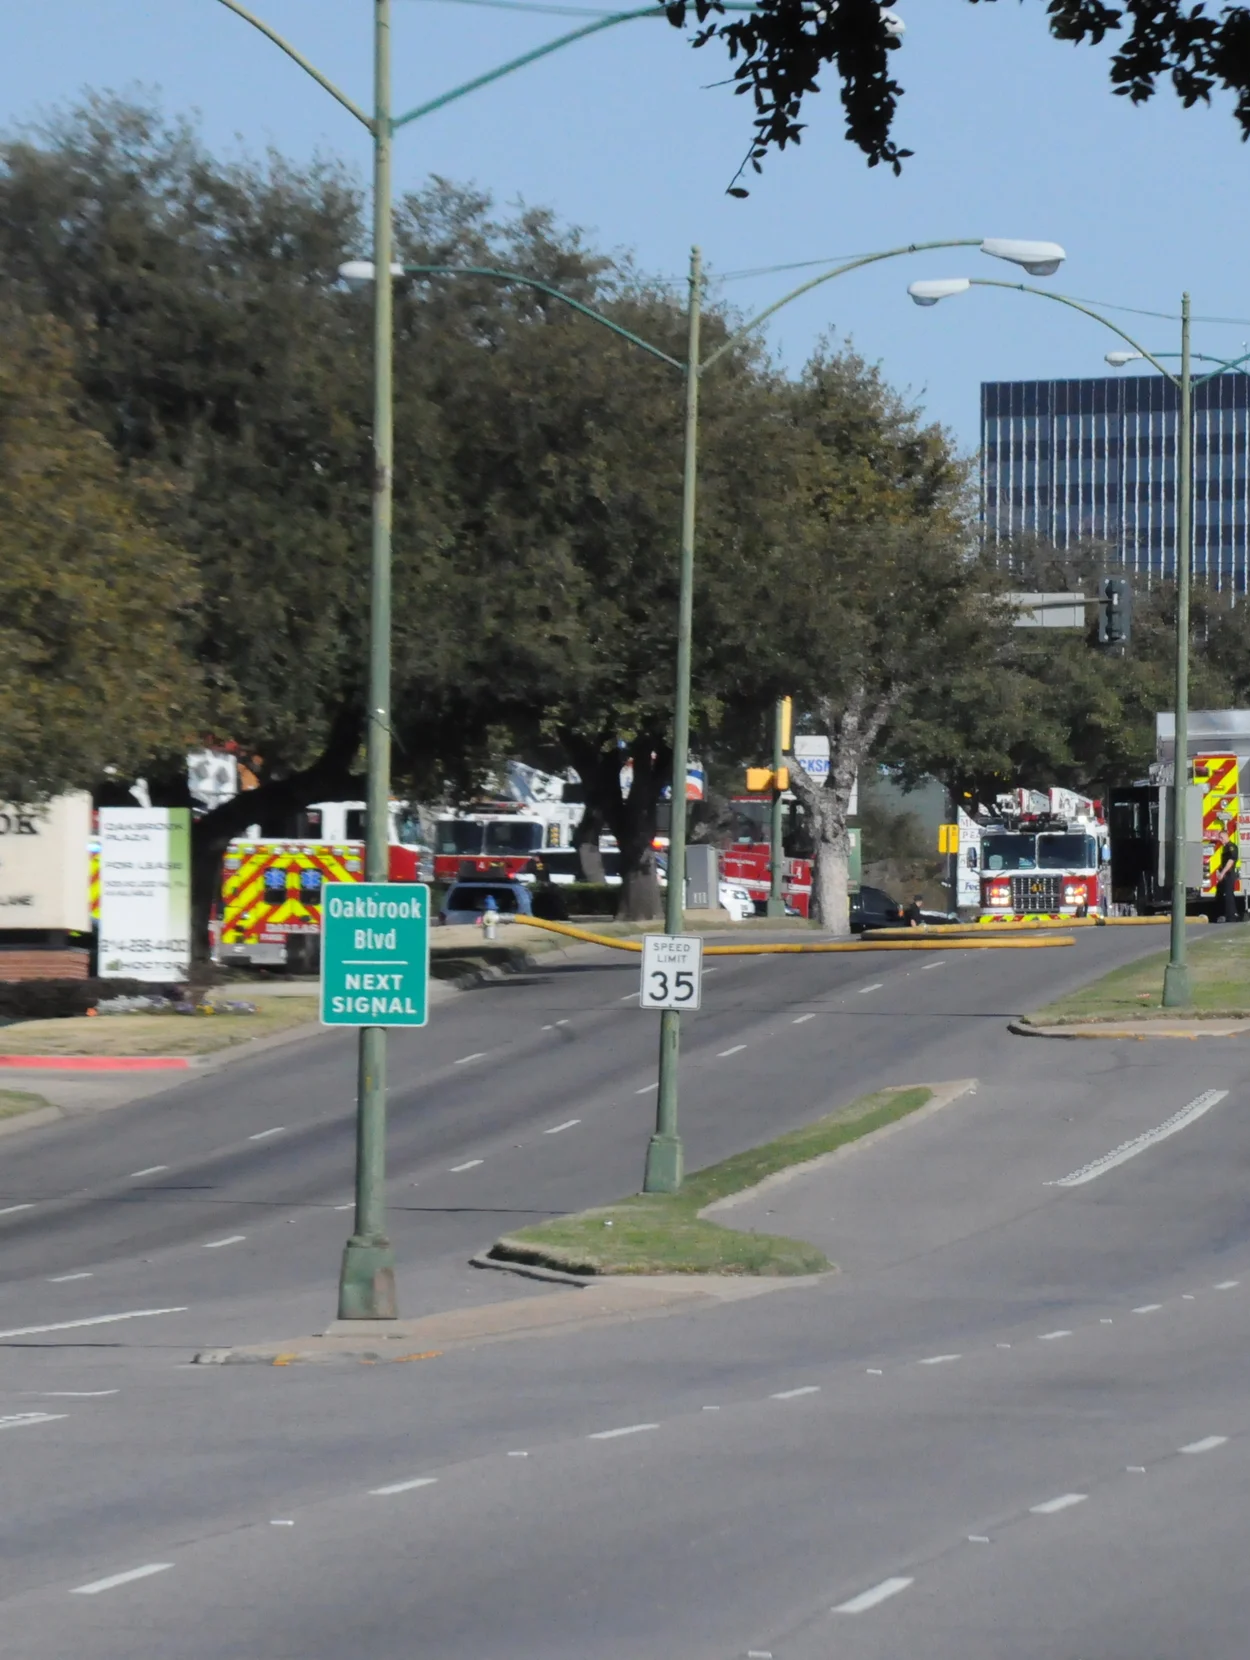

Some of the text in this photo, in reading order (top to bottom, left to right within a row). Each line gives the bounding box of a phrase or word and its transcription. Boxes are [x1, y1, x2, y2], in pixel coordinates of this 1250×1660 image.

[329, 897, 421, 918] Oakbrook
[354, 928, 396, 949] Blvd
[653, 942, 691, 952] SPEED
[657, 954, 687, 963] LIMIT
[345, 974, 403, 990] NEXT
[649, 970, 694, 1001] 35
[332, 997, 417, 1015] SIGNAL
